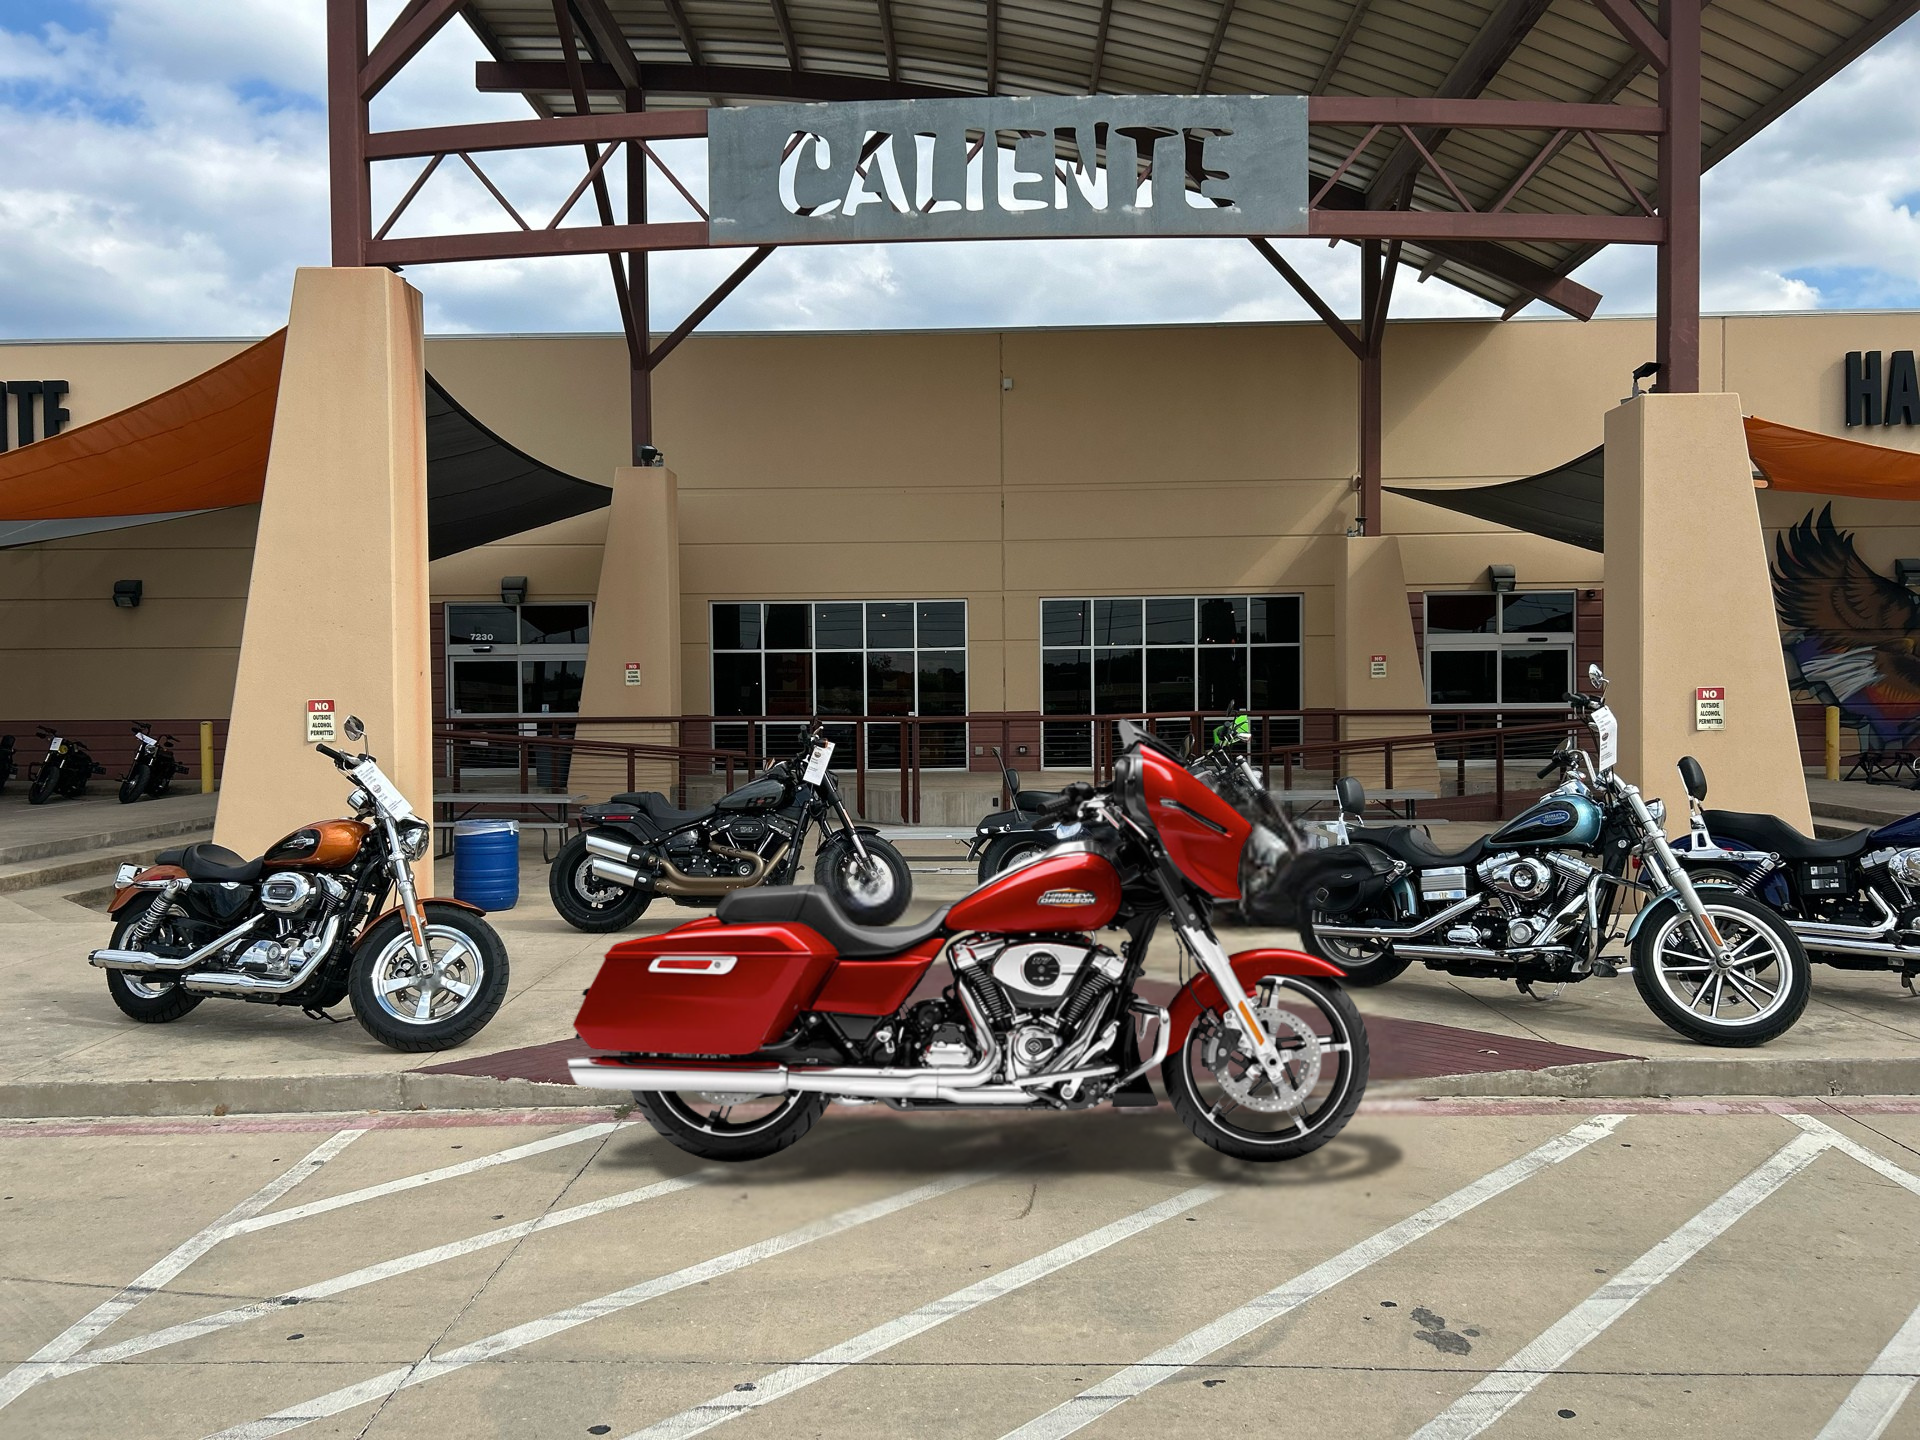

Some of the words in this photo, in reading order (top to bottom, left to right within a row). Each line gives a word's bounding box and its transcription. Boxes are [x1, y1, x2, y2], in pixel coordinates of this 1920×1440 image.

[779, 122, 1235, 217] CALIENTE
[0, 380, 70, 452] TE
[470, 633, 494, 641] 7230
[1702, 690, 1717, 698] NO
[314, 702, 329, 710] NO
